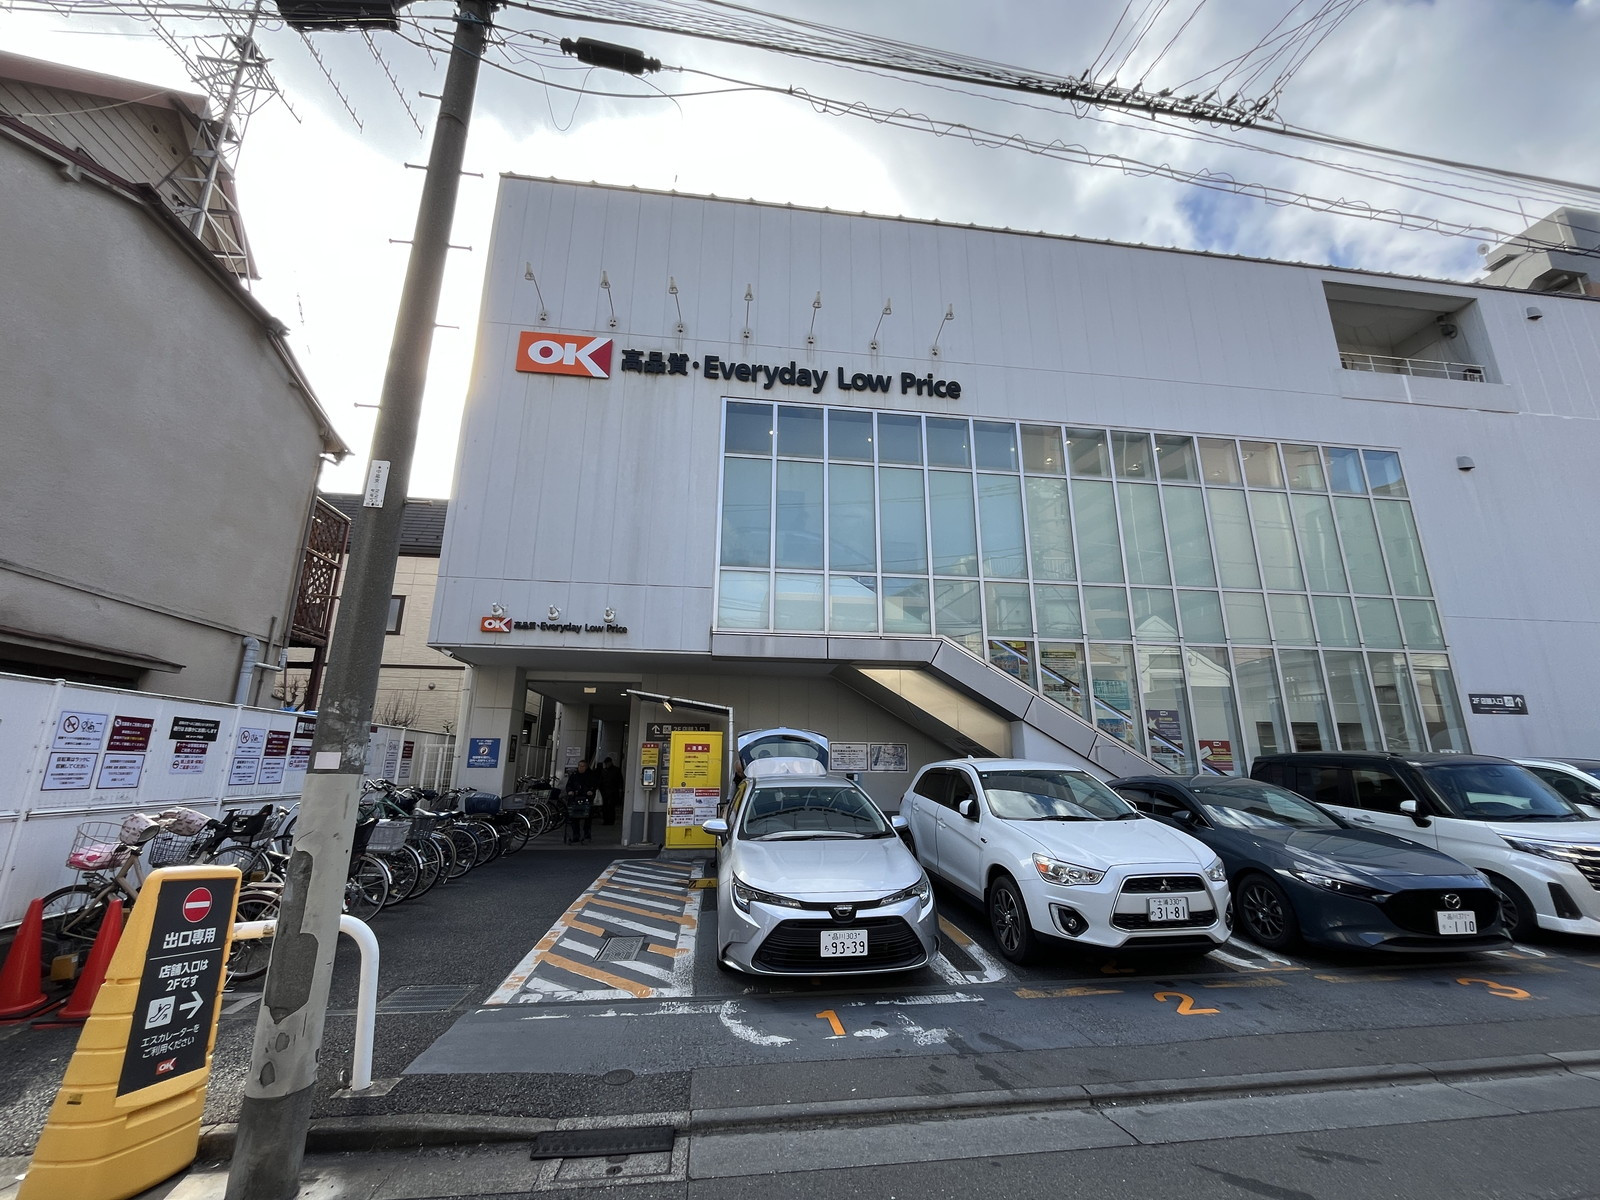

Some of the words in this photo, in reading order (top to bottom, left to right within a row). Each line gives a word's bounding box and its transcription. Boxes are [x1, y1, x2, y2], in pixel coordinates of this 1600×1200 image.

[526, 337, 613, 378] OK
[838, 366, 892, 393] Low
[901, 372, 962, 399] Price
[484, 617, 512, 632] OK
[585, 623, 604, 633] Low
[606, 625, 628, 634] Price
[1157, 906, 1186, 919] 31-81
[163, 927, 216, 949] 出口専用
[831, 941, 865, 954] 93-39
[159, 959, 209, 979] 店舗入口は
[166, 975, 199, 992] 2Fです
[1456, 978, 1532, 999] 3
[1153, 991, 1221, 1015] 2
[816, 1010, 846, 1036] 1
[140, 1024, 200, 1048] エスカレーターを
[142, 1037, 195, 1059] ご利用ください
[158, 1057, 177, 1071] OK
